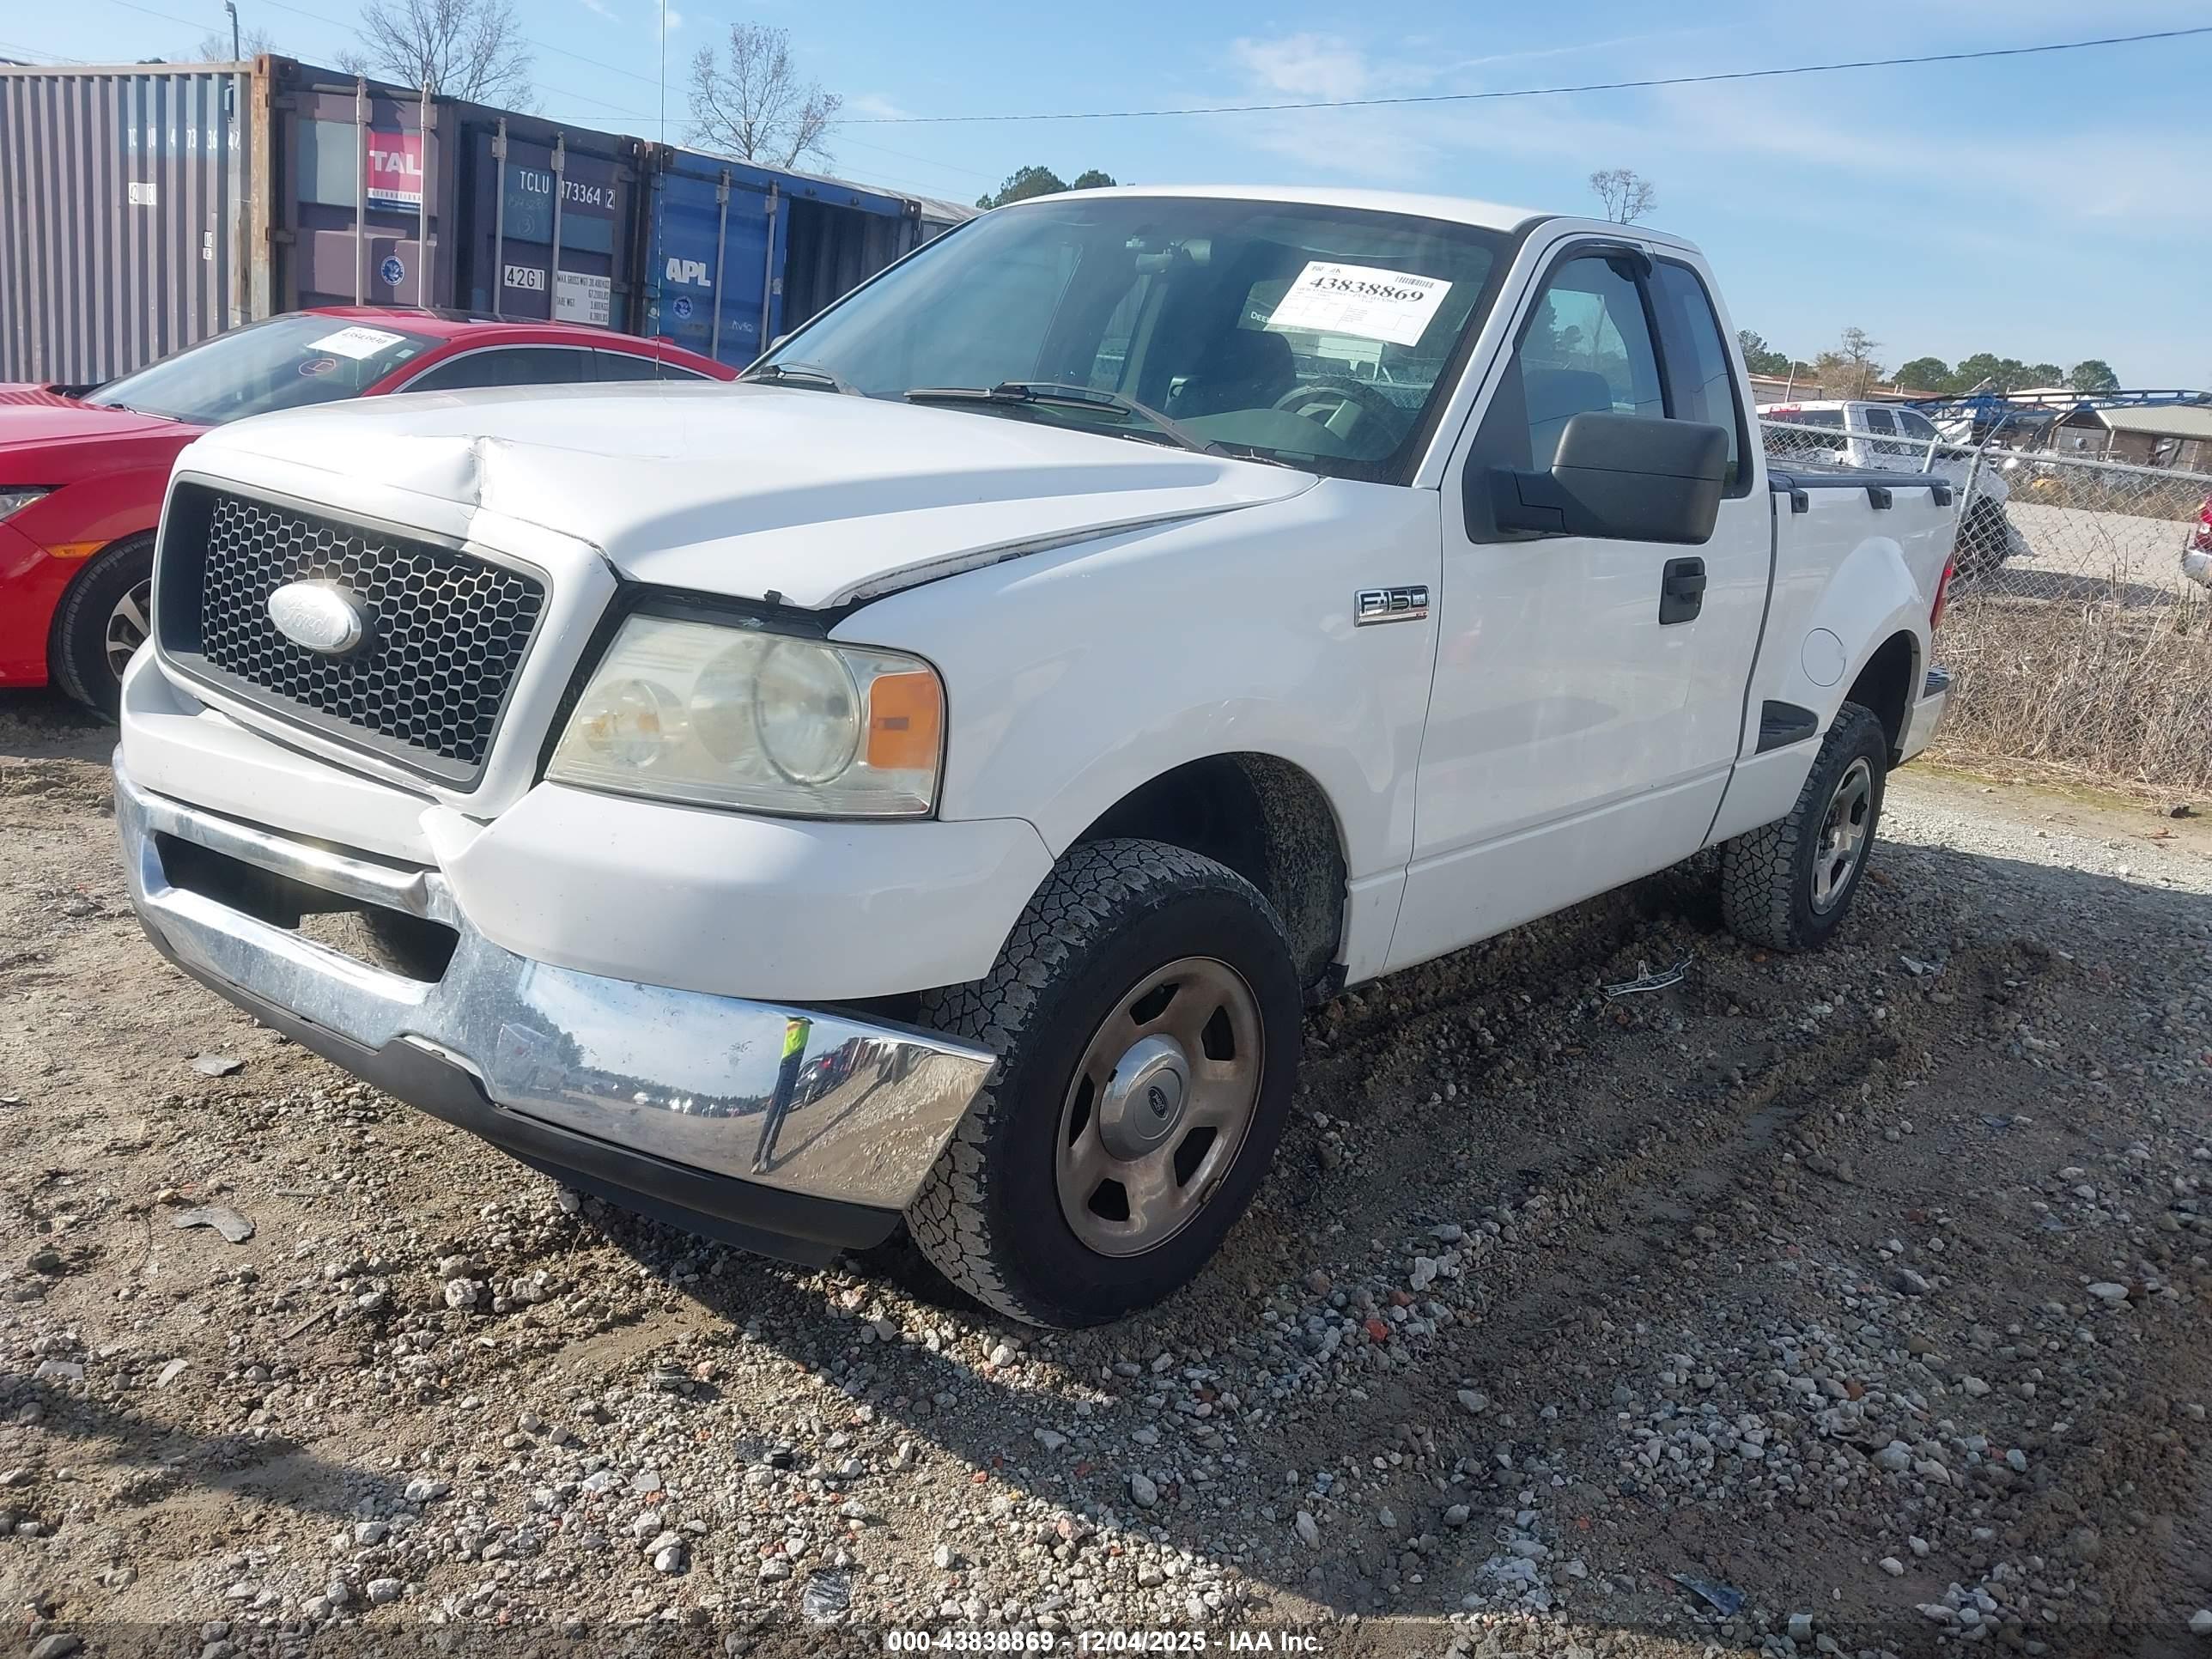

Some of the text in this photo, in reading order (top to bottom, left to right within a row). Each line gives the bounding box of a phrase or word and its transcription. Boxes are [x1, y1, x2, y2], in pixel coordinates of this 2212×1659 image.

[369, 149, 422, 176] TAL
[520, 171, 550, 194] TCLU
[606, 190, 615, 208] 2
[507, 268, 544, 289] 42G1
[666, 258, 712, 287] APL
[1310, 276, 1425, 302] 43838869
